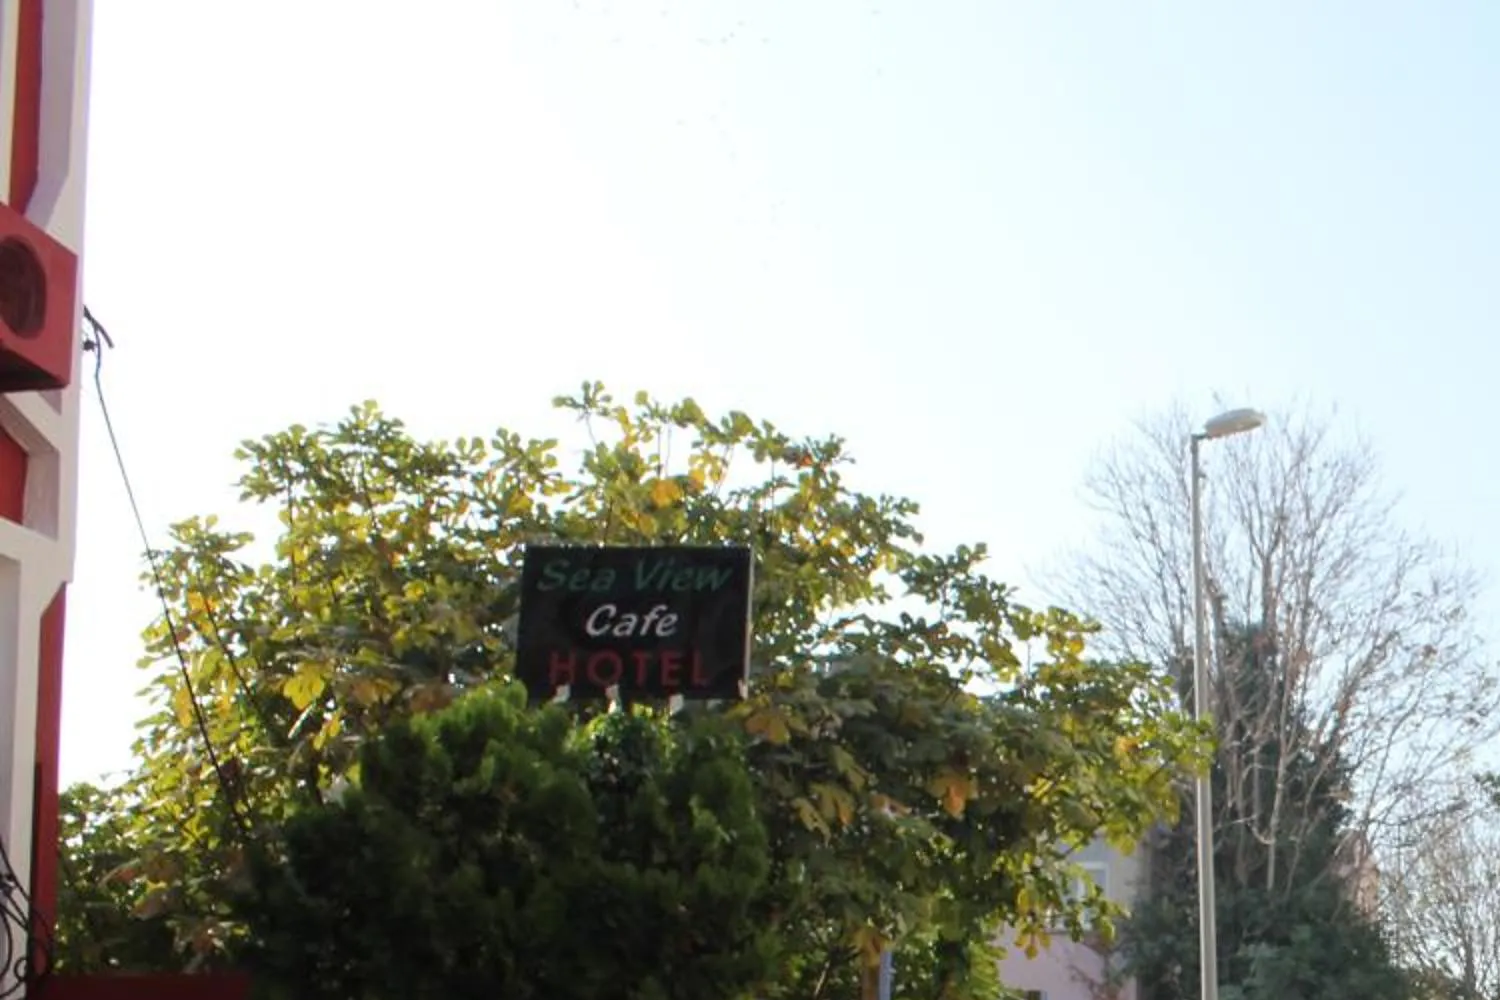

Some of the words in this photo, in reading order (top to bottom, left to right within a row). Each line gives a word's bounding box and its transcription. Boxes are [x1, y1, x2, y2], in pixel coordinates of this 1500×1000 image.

[537, 558, 616, 593] Sea
[632, 556, 733, 592] View
[585, 603, 679, 637] Cafe
[547, 649, 711, 687] HOTEL
